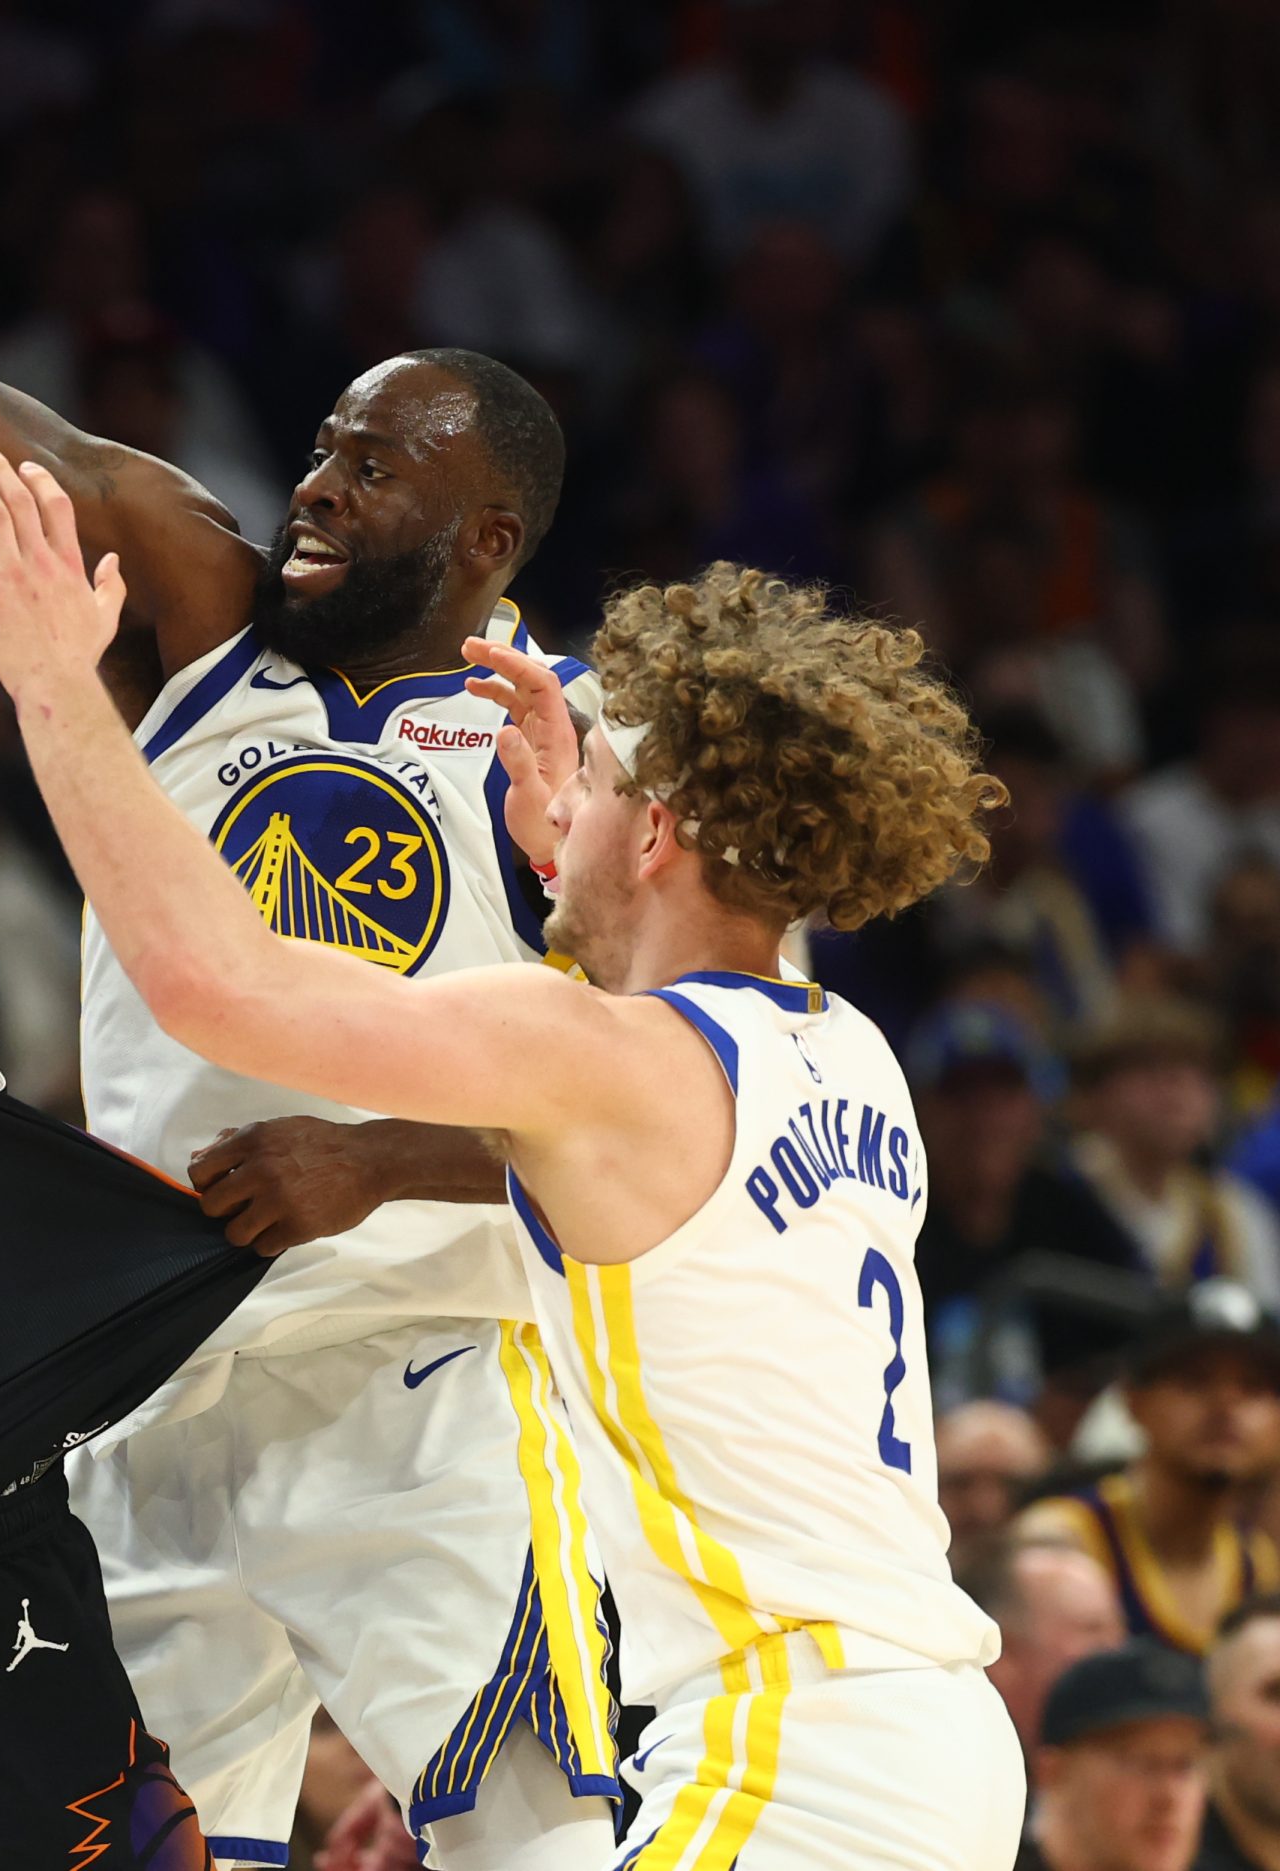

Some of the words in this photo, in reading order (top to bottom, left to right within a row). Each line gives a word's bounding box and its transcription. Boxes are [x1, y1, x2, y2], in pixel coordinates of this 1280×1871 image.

[398, 719, 493, 749] Rakuten
[335, 826, 423, 900] 23
[858, 1247, 911, 1475] 2
